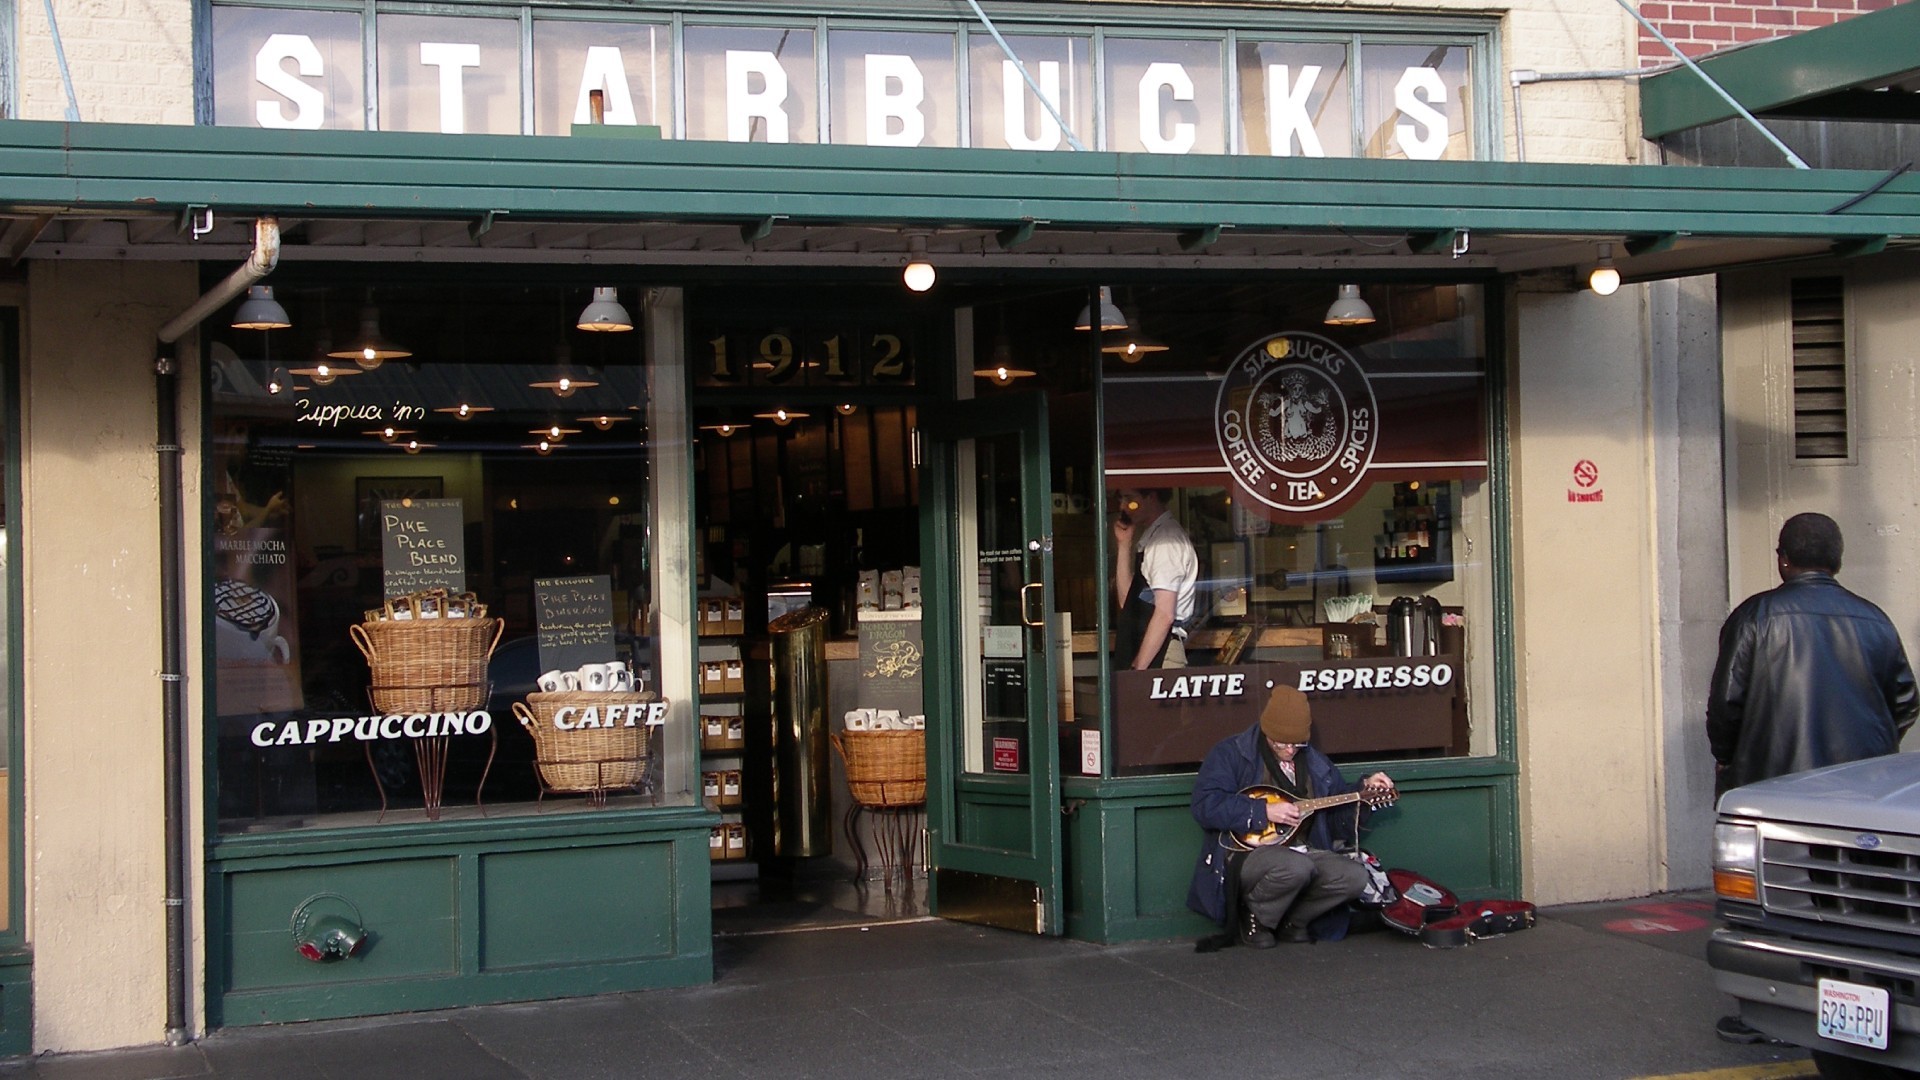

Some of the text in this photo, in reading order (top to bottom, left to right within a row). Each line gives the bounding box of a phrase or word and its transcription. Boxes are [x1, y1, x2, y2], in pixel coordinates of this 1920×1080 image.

[255, 33, 1450, 161] STARBUCKS
[709, 334, 904, 377] 1912
[1243, 339, 1346, 379] STABUCKS
[1223, 409, 1265, 485] COFFEE
[1340, 407, 1369, 474] SPICES
[1287, 480, 1324, 501] TEA
[384, 514, 429, 532] PIKE
[220, 540, 286, 551] MARBLE MOCHA
[395, 534, 446, 549] PLACE
[235, 554, 286, 565] MACCHIATO
[410, 551, 457, 567] BLEND
[861, 623, 896, 631] KOMODO
[869, 630, 906, 640] DRAGON
[1150, 664, 1453, 699] LATTE ESPRESSO
[251, 702, 667, 747] CAPPUCCINO CAFFE
[1823, 989, 1861, 1002] WASHINGTON
